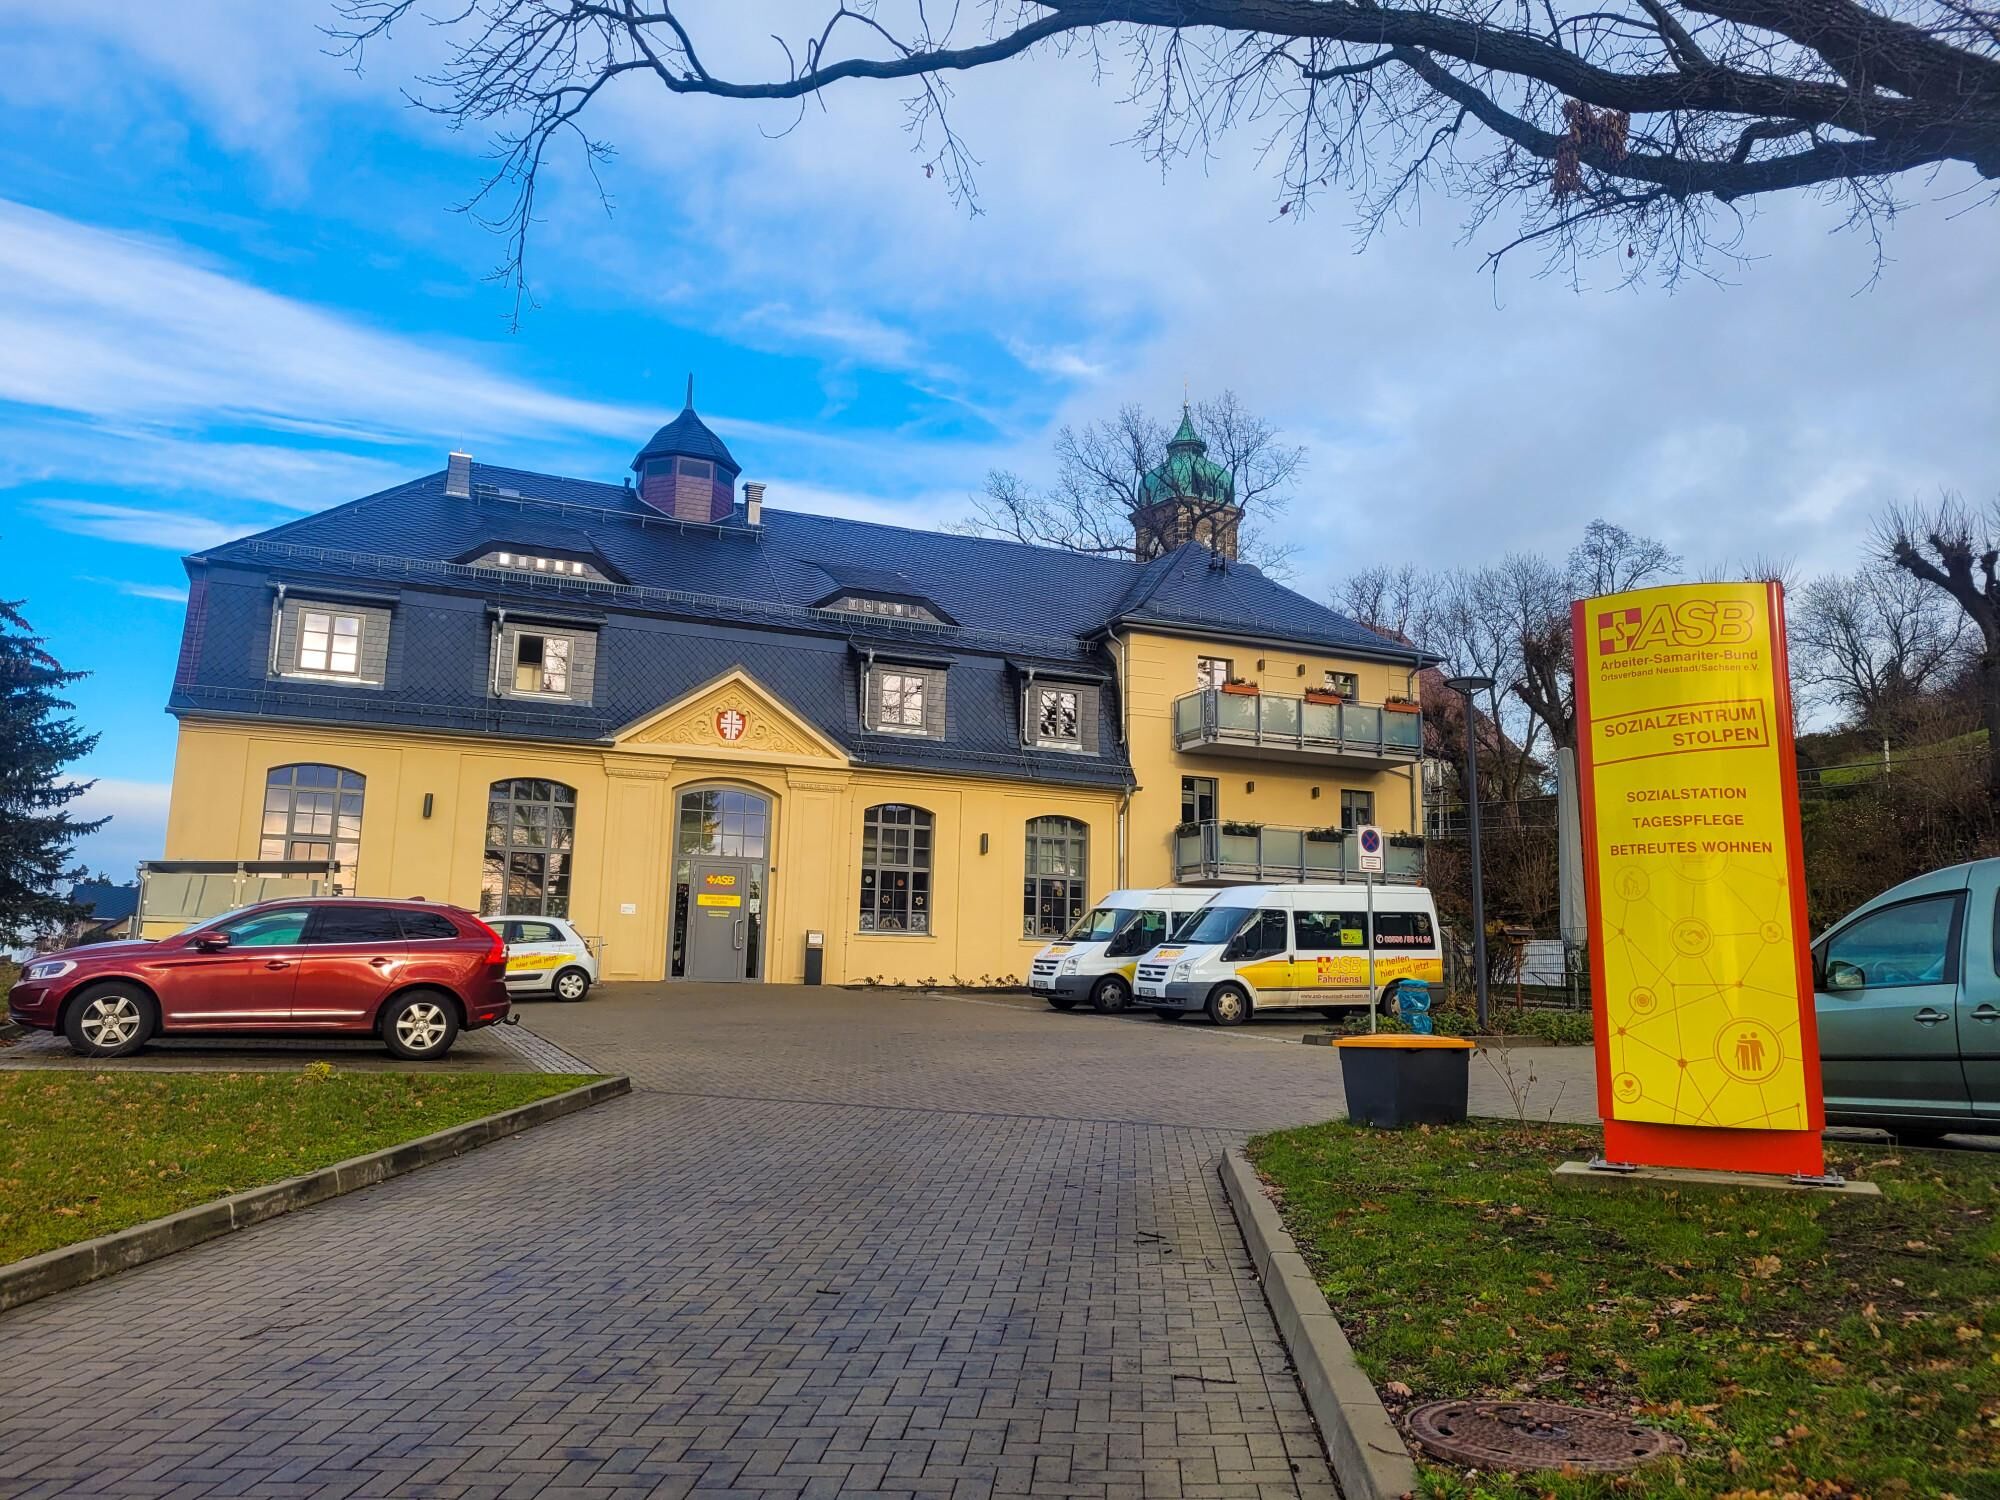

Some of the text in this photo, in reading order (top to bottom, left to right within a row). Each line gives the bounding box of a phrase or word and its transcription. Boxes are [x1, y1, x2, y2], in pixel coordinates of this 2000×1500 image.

[1631, 600, 1755, 651] ASB
[1601, 649, 1758, 672] Arbeiter-Samariter-Bund
[1601, 663, 1759, 682] Ortsverband Neustadt/Sachsen e.V.
[1604, 707, 1757, 737] SOZIALZENTRUM
[1673, 727, 1759, 746] STOLPEN
[1626, 787, 1747, 803] SOZIALSTATION
[1632, 814, 1744, 829] TAGESPFLEGE
[1610, 841, 1773, 856] BETREUTES WOHNEN
[713, 874, 736, 885] ASB
[1329, 955, 1361, 973] ASB
[1385, 955, 1410, 967] helfen
[1380, 968, 1396, 977] hier
[1397, 964, 1412, 974] und
[1317, 974, 1362, 984] Fahrdienst
